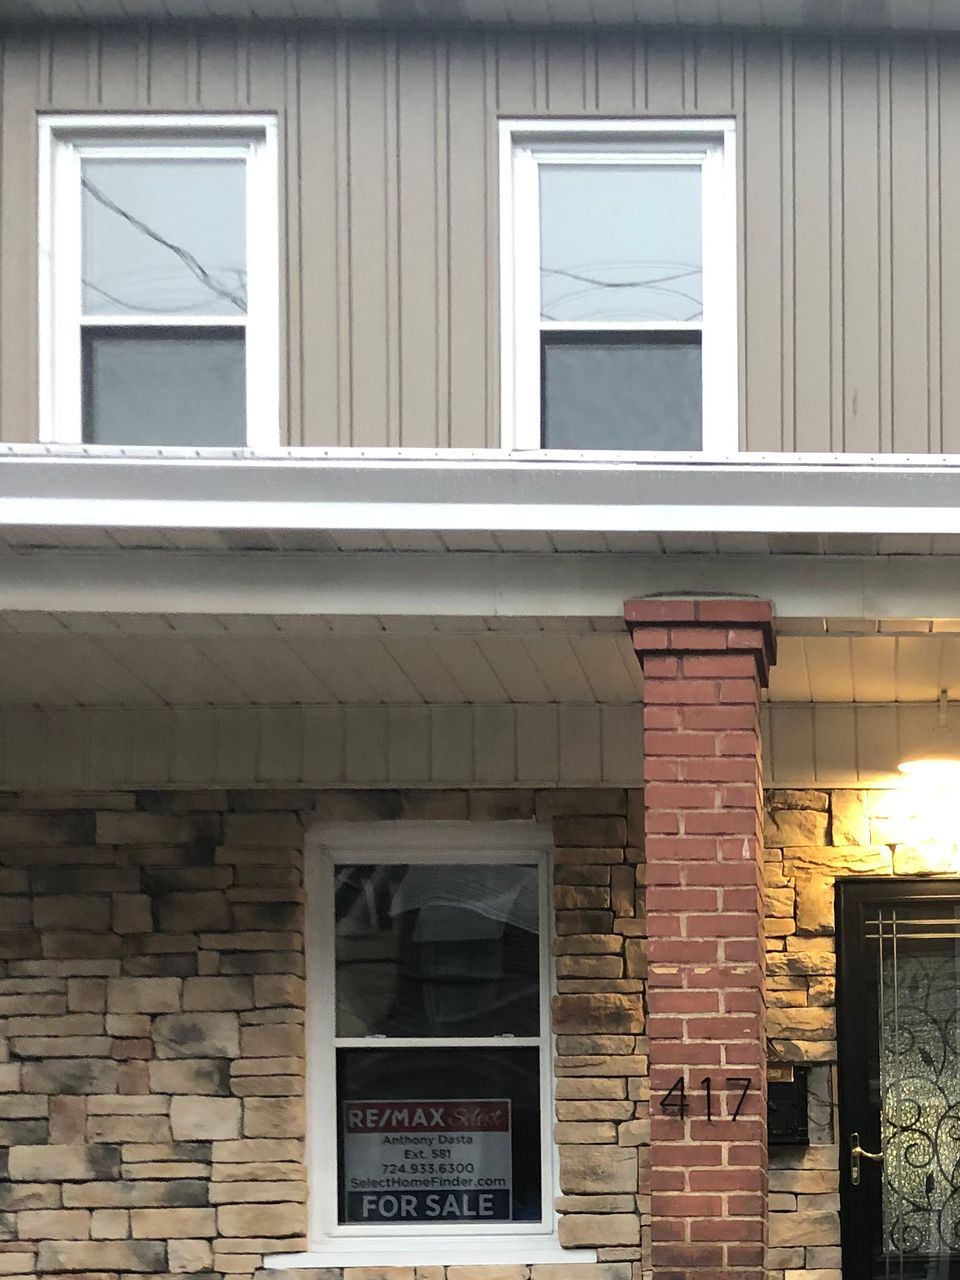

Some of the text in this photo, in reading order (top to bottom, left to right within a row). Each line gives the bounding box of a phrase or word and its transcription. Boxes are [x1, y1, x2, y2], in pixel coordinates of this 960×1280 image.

[659, 1076, 752, 1122] 417
[348, 1107, 445, 1128] RE/MAX
[383, 1134, 434, 1147] Anthony
[431, 1148, 452, 1159] 581
[382, 1162, 474, 1175] 724.933.6300
[350, 1176, 506, 1189] SelectHomeFinder.com
[362, 1193, 494, 1218] FOR SALE
